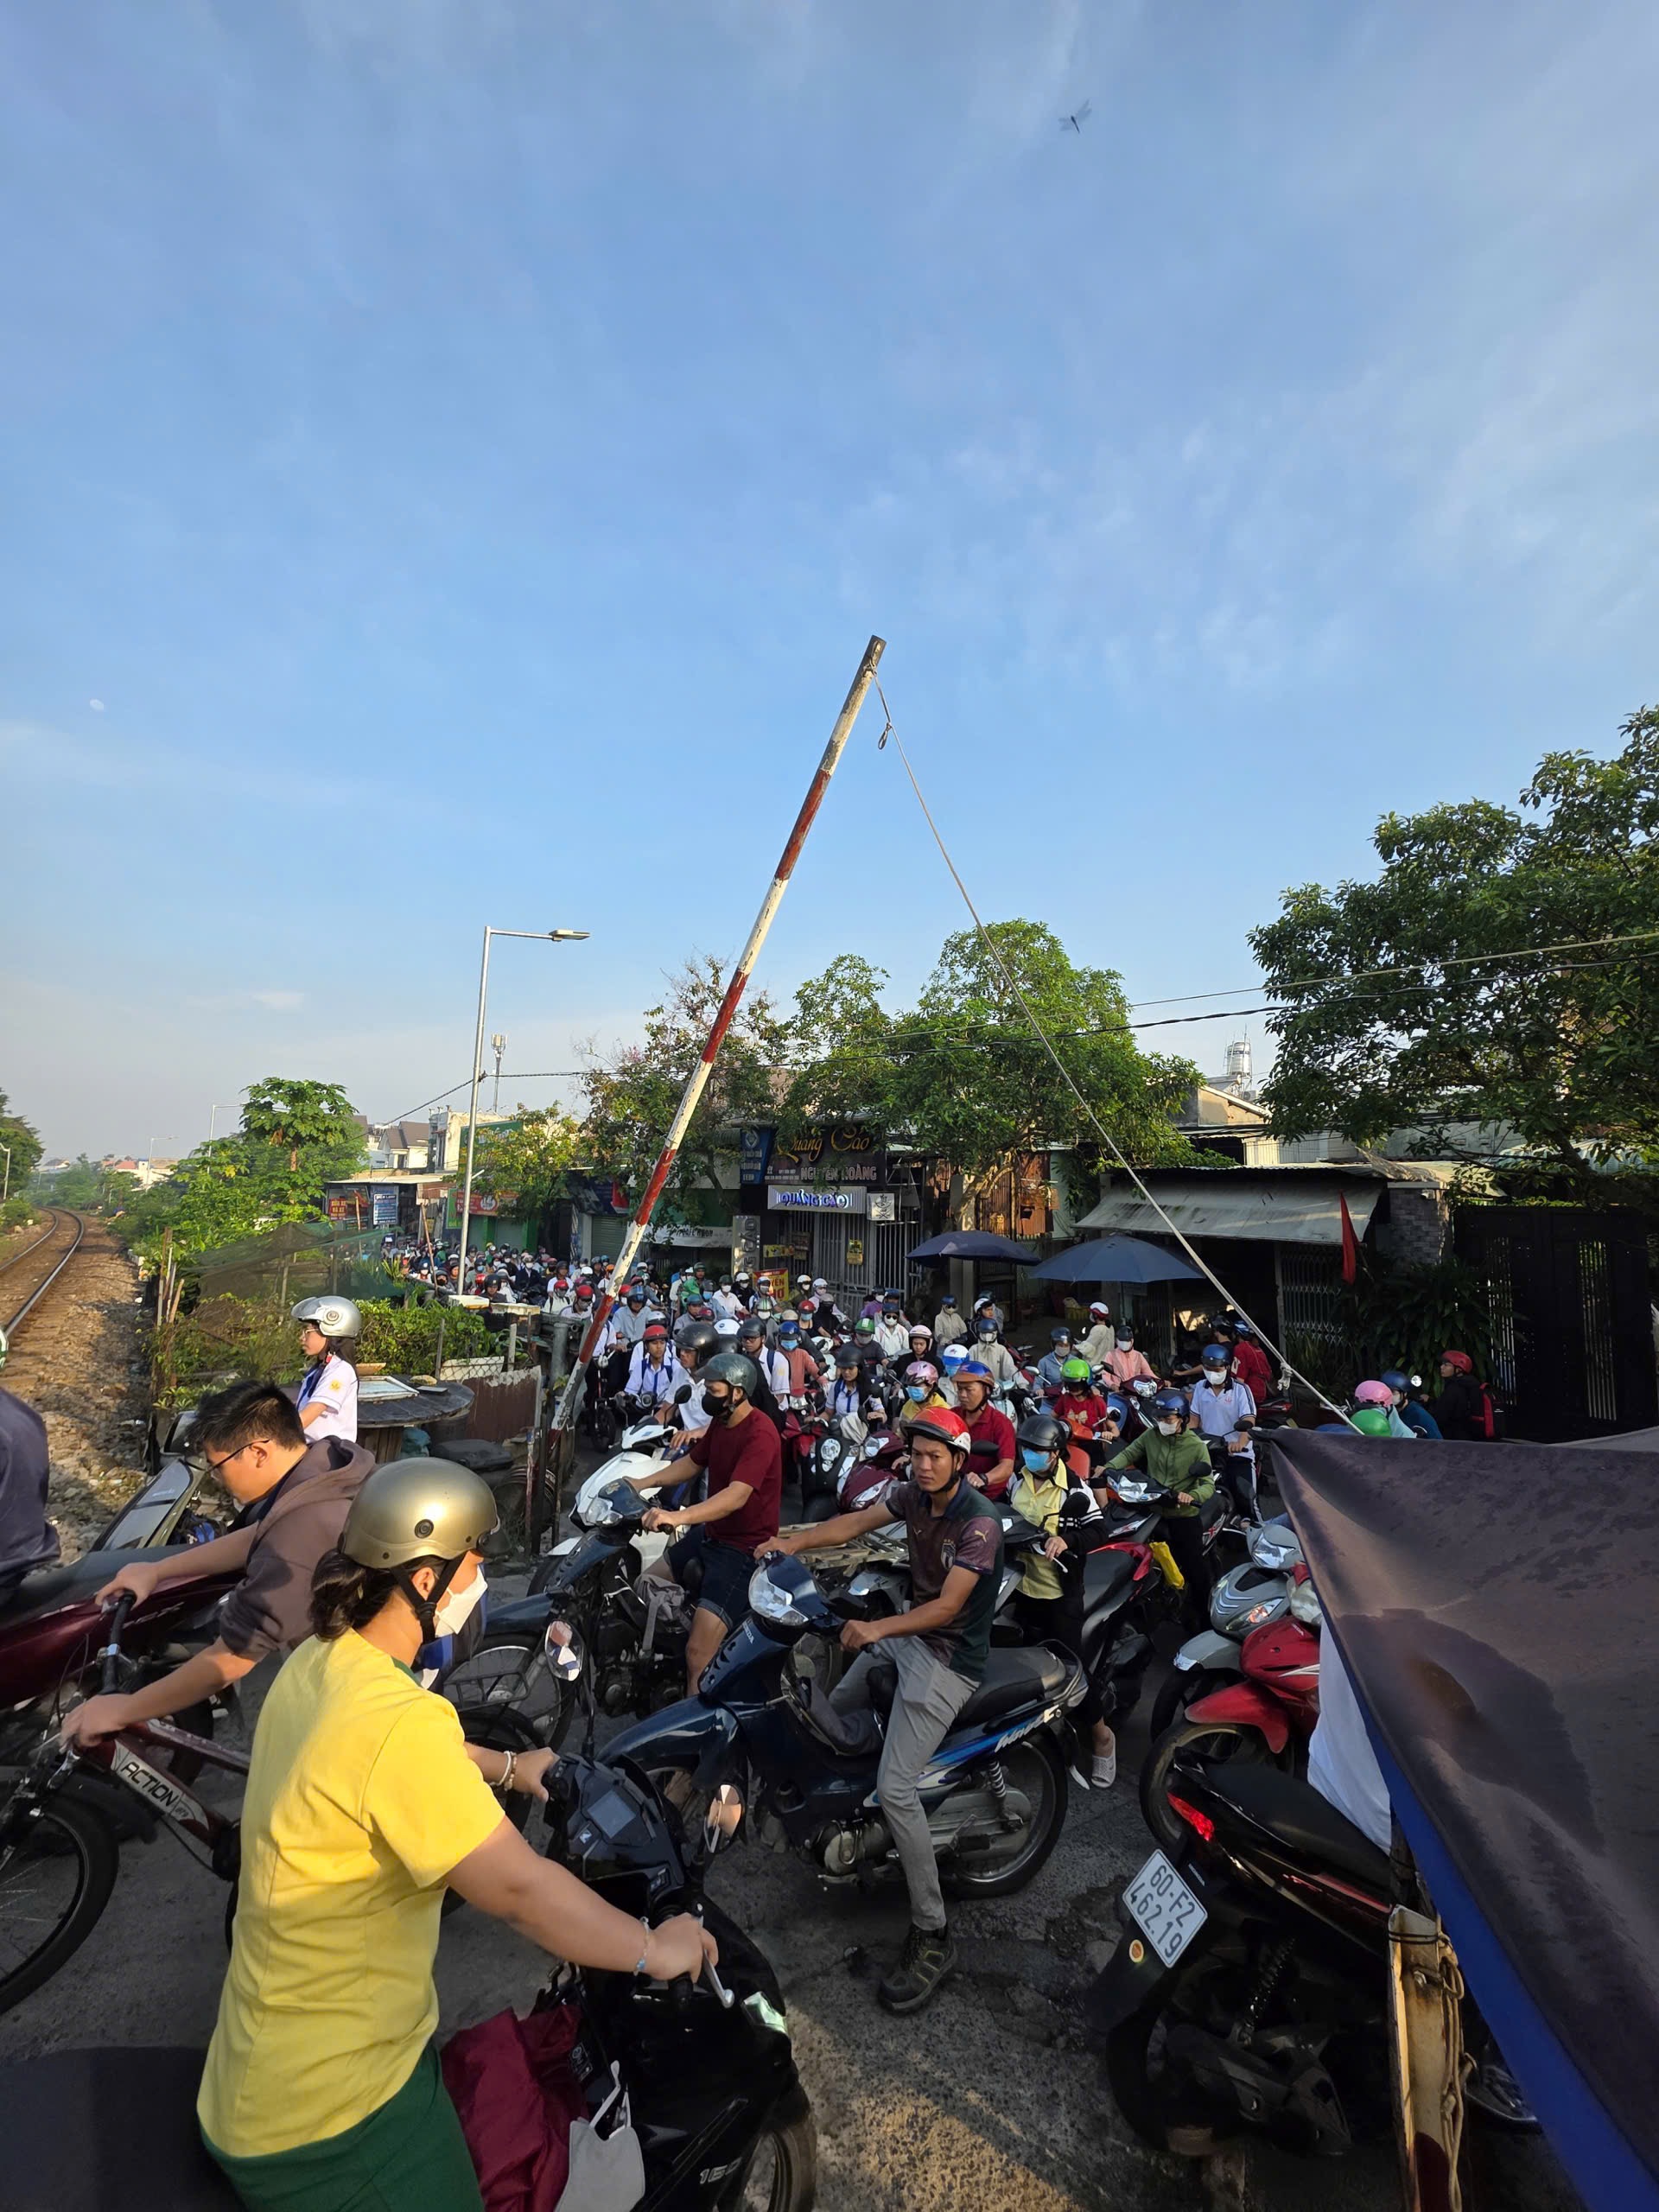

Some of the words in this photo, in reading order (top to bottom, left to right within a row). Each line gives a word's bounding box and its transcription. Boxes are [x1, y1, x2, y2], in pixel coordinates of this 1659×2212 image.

[779, 1189, 820, 1207] QUẢNG
[121, 1761, 180, 1808] ACTION
[1130, 1882, 1183, 1958] 462.19
